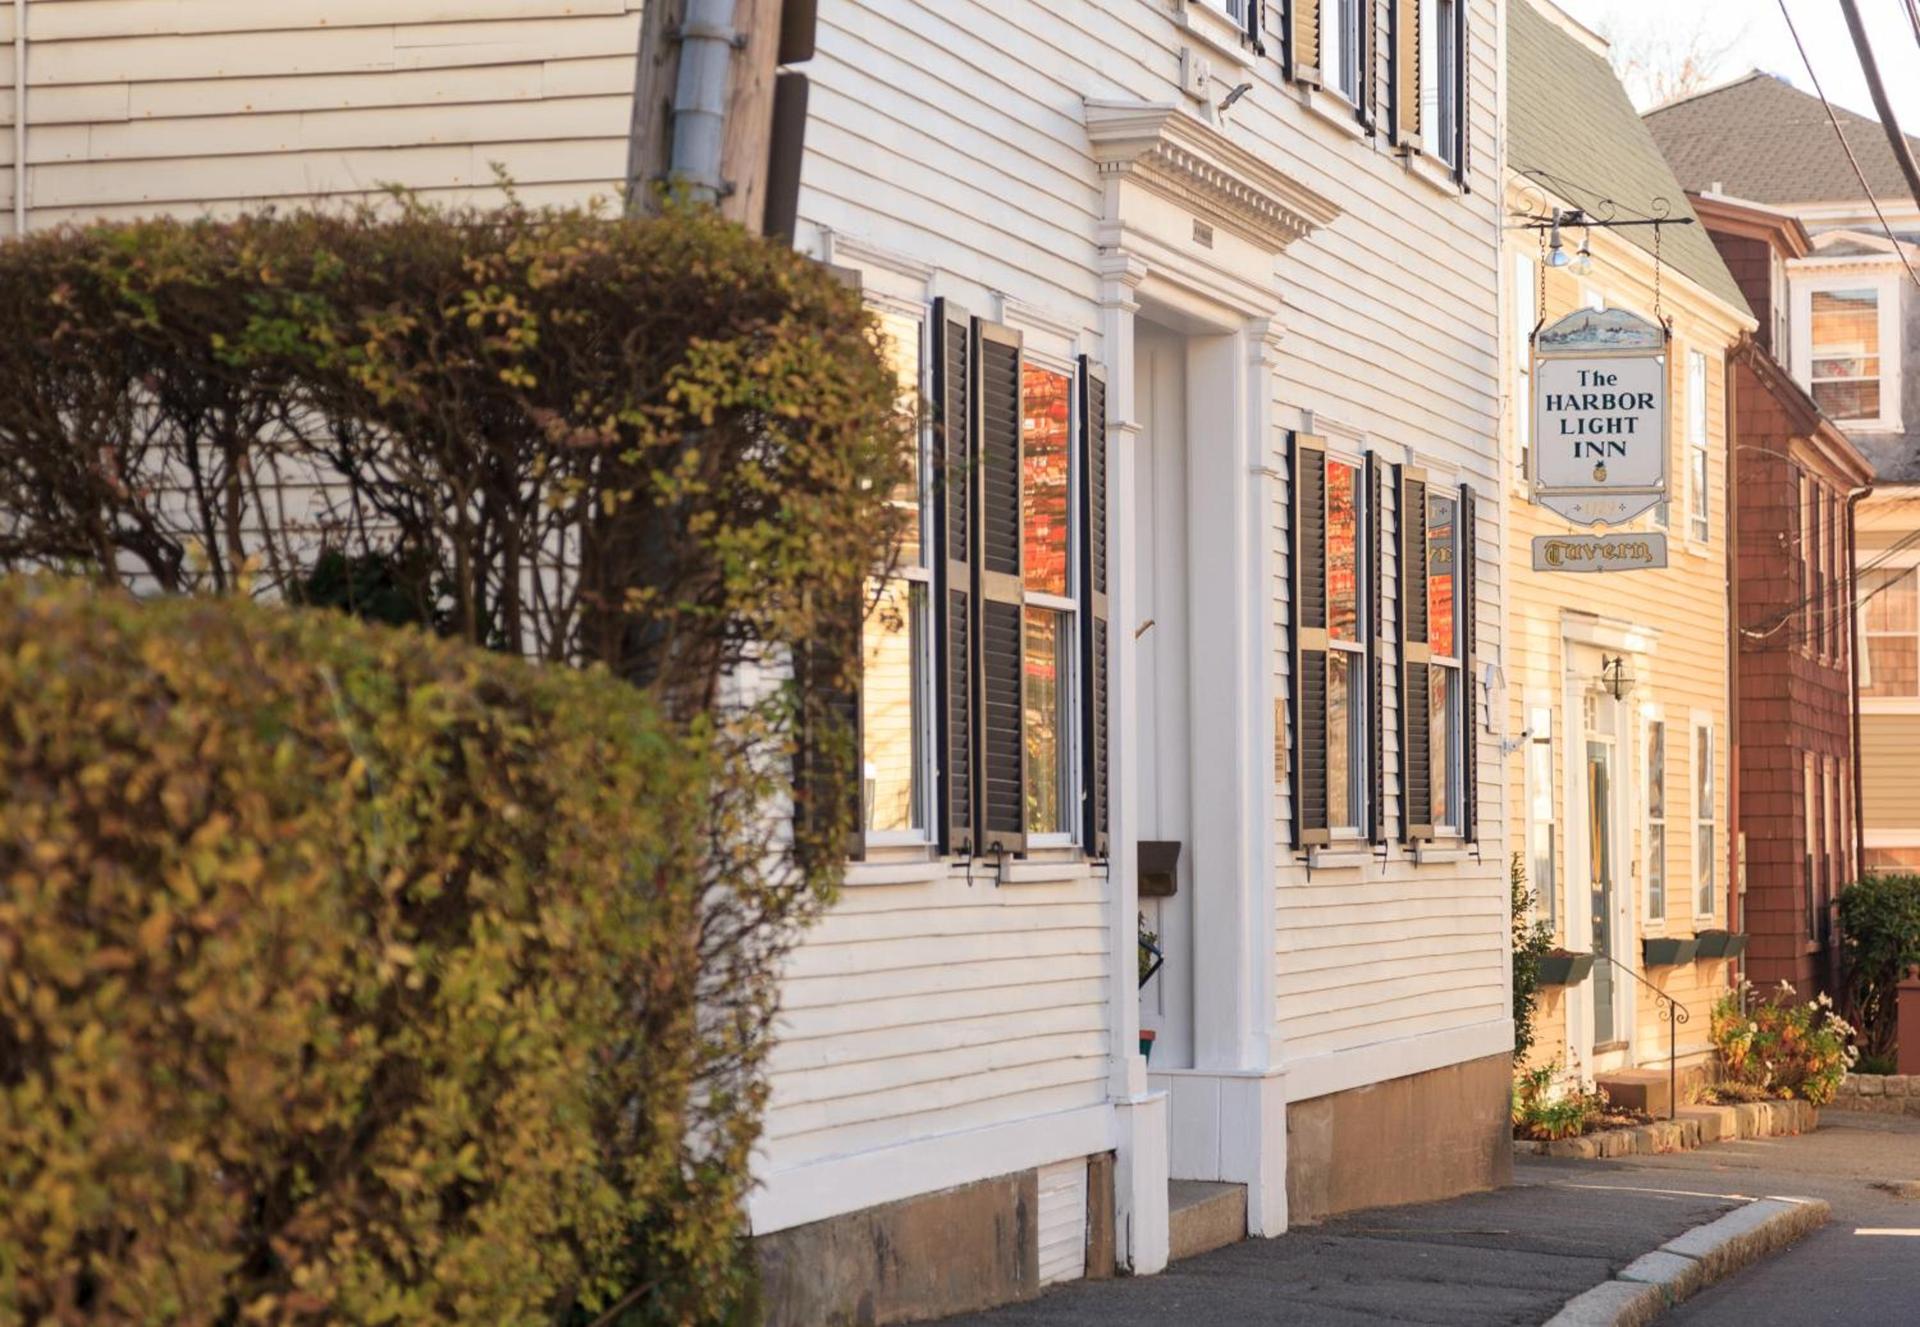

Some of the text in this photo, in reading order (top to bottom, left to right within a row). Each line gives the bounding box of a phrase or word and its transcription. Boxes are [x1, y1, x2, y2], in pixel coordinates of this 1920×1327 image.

[1577, 370, 1618, 387] The
[1546, 392, 1656, 411] HARBOR
[1560, 416, 1639, 435] LIGHT
[1574, 440, 1626, 458] INN
[1544, 540, 1653, 566] Tavern
